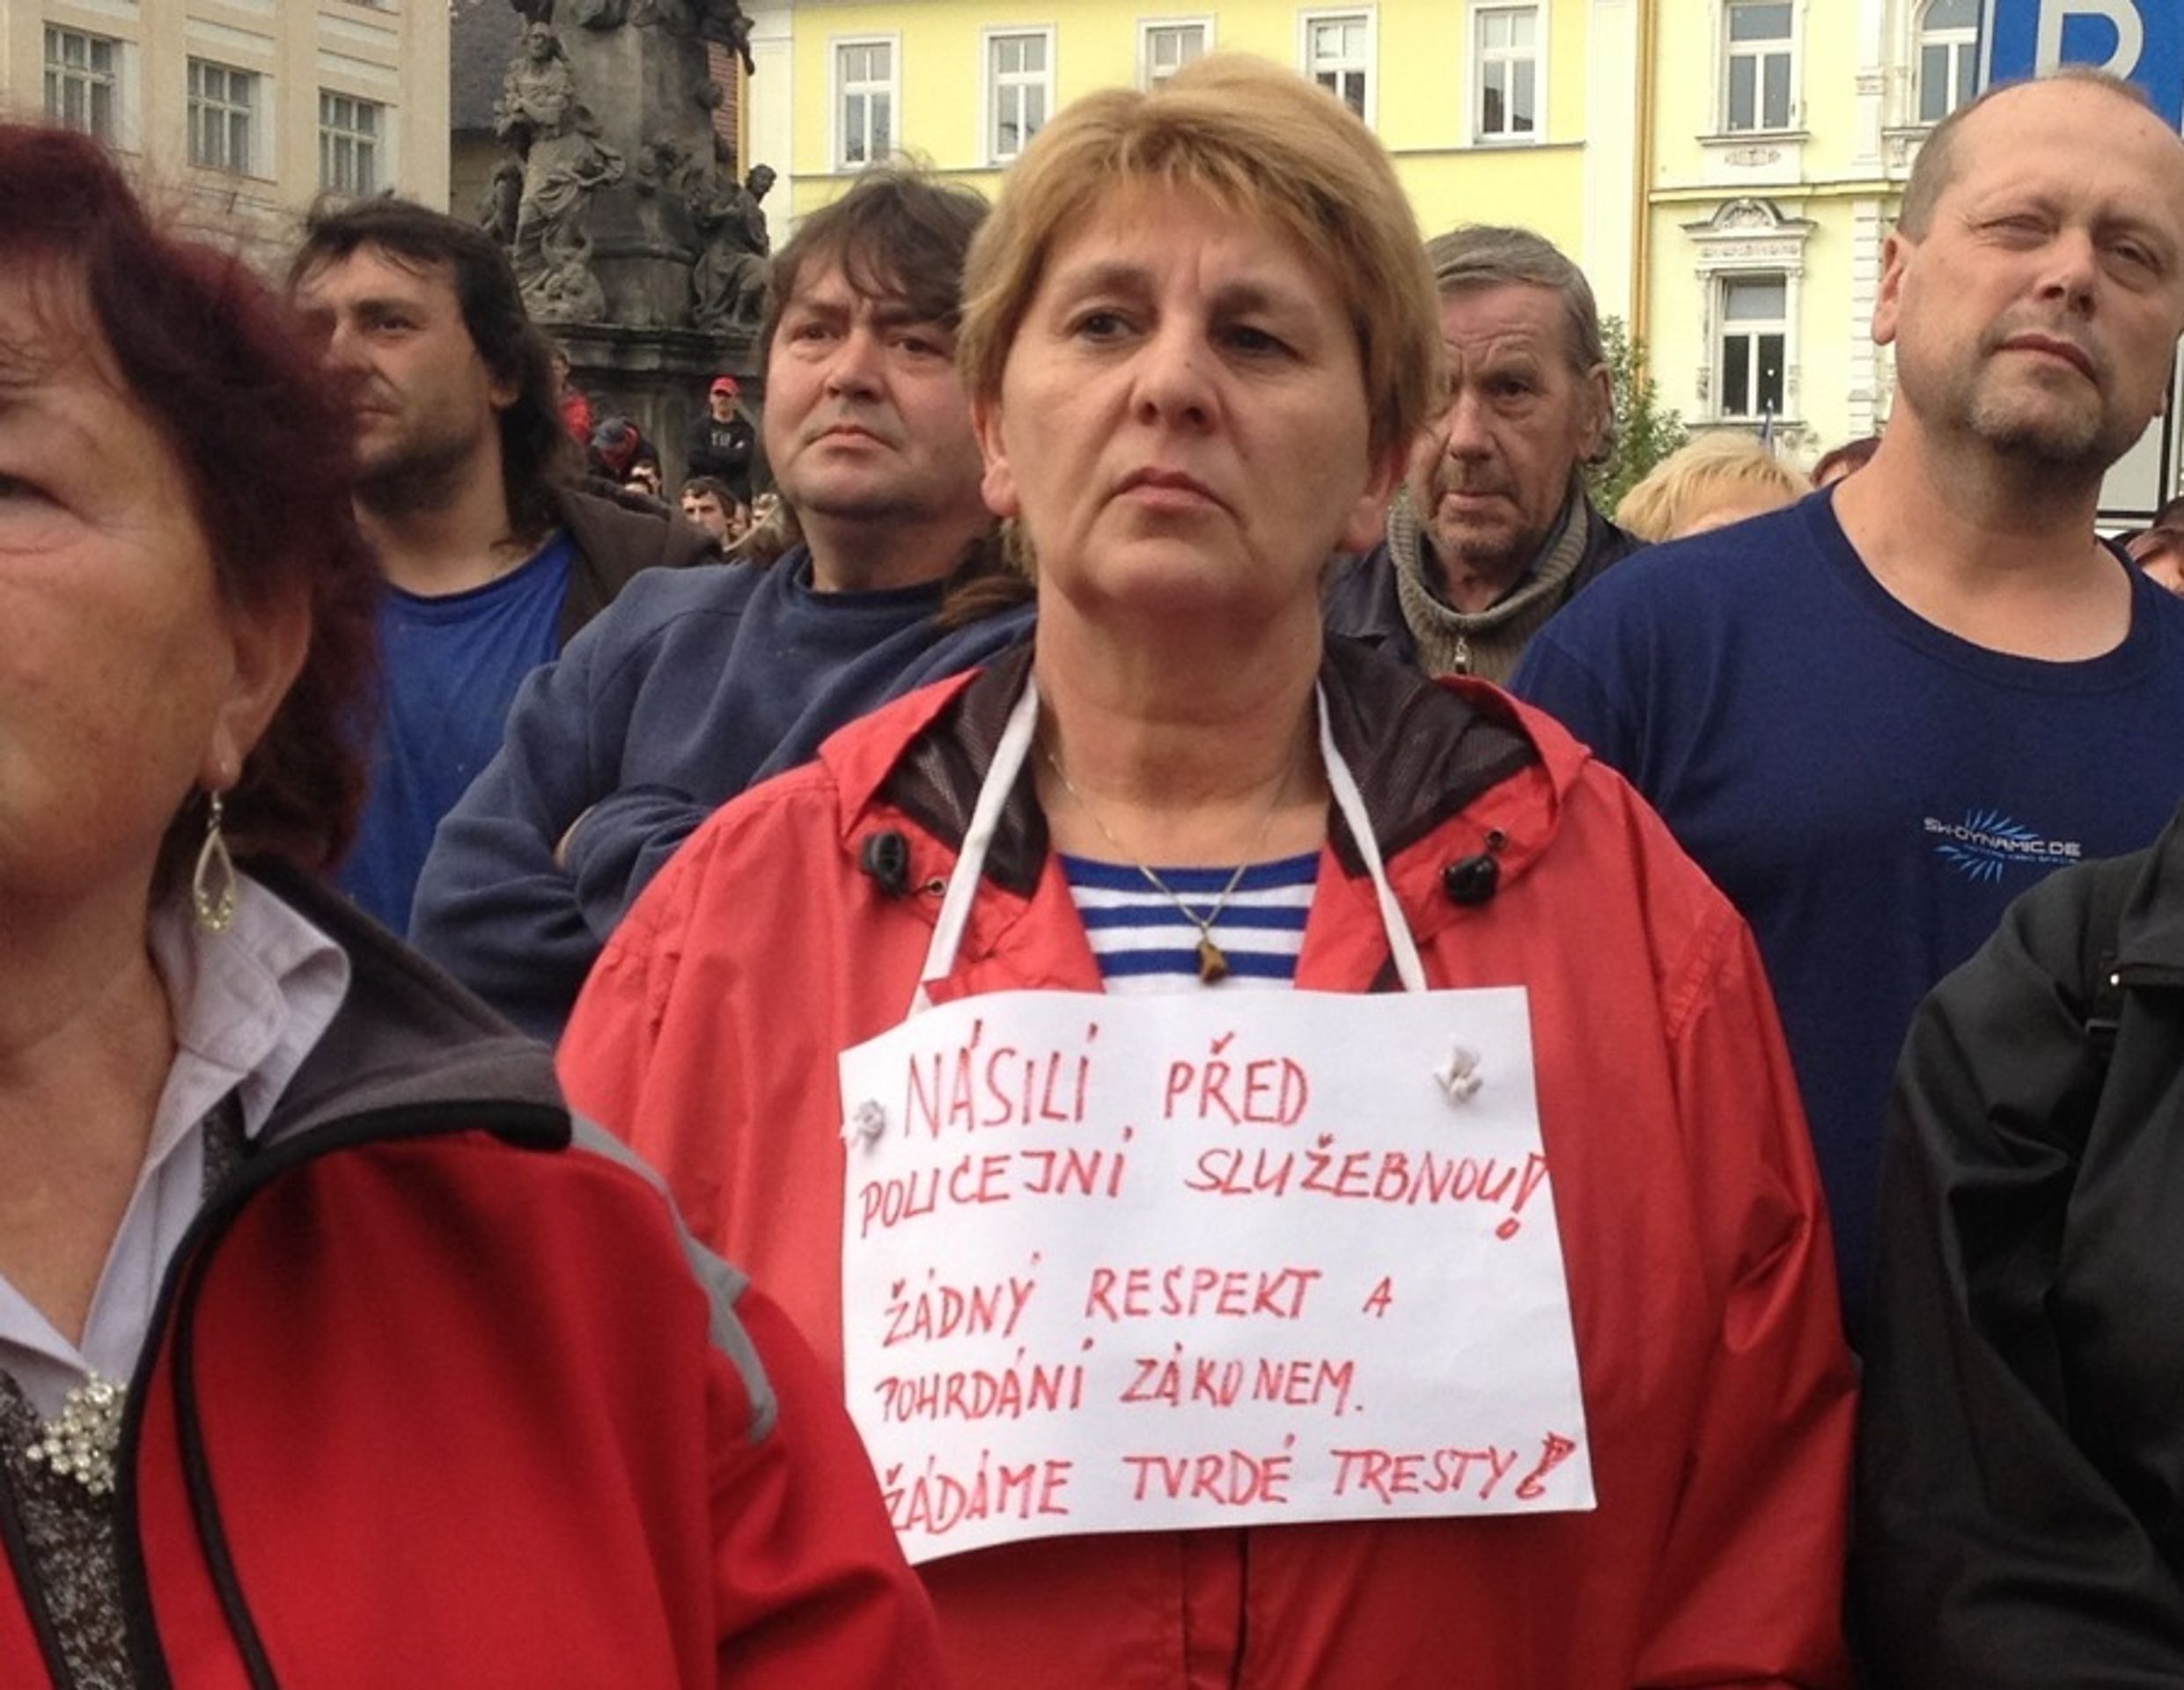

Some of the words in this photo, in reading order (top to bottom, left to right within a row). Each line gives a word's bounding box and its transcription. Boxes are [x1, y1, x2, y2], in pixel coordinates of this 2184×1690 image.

[905, 1018, 1098, 1139] NÁSILÍ
[1164, 1031, 1309, 1126] PŘED
[859, 1127, 1133, 1238] POLICEJNÍ
[1184, 1134, 1549, 1240] SLUŽEBNOU!
[883, 1251, 1042, 1348] ŽÁDNÝ
[1085, 1266, 1321, 1322] RESPEKT
[1362, 1276, 1393, 1318] A
[875, 1337, 1094, 1422] POHRDÁNÍ
[1120, 1341, 1364, 1416] ZÁKONEM.
[884, 1449, 1073, 1534] ŽÁDÁME
[1122, 1432, 1296, 1505] TVRDÉ
[1329, 1431, 1577, 1505] TRESTY!
